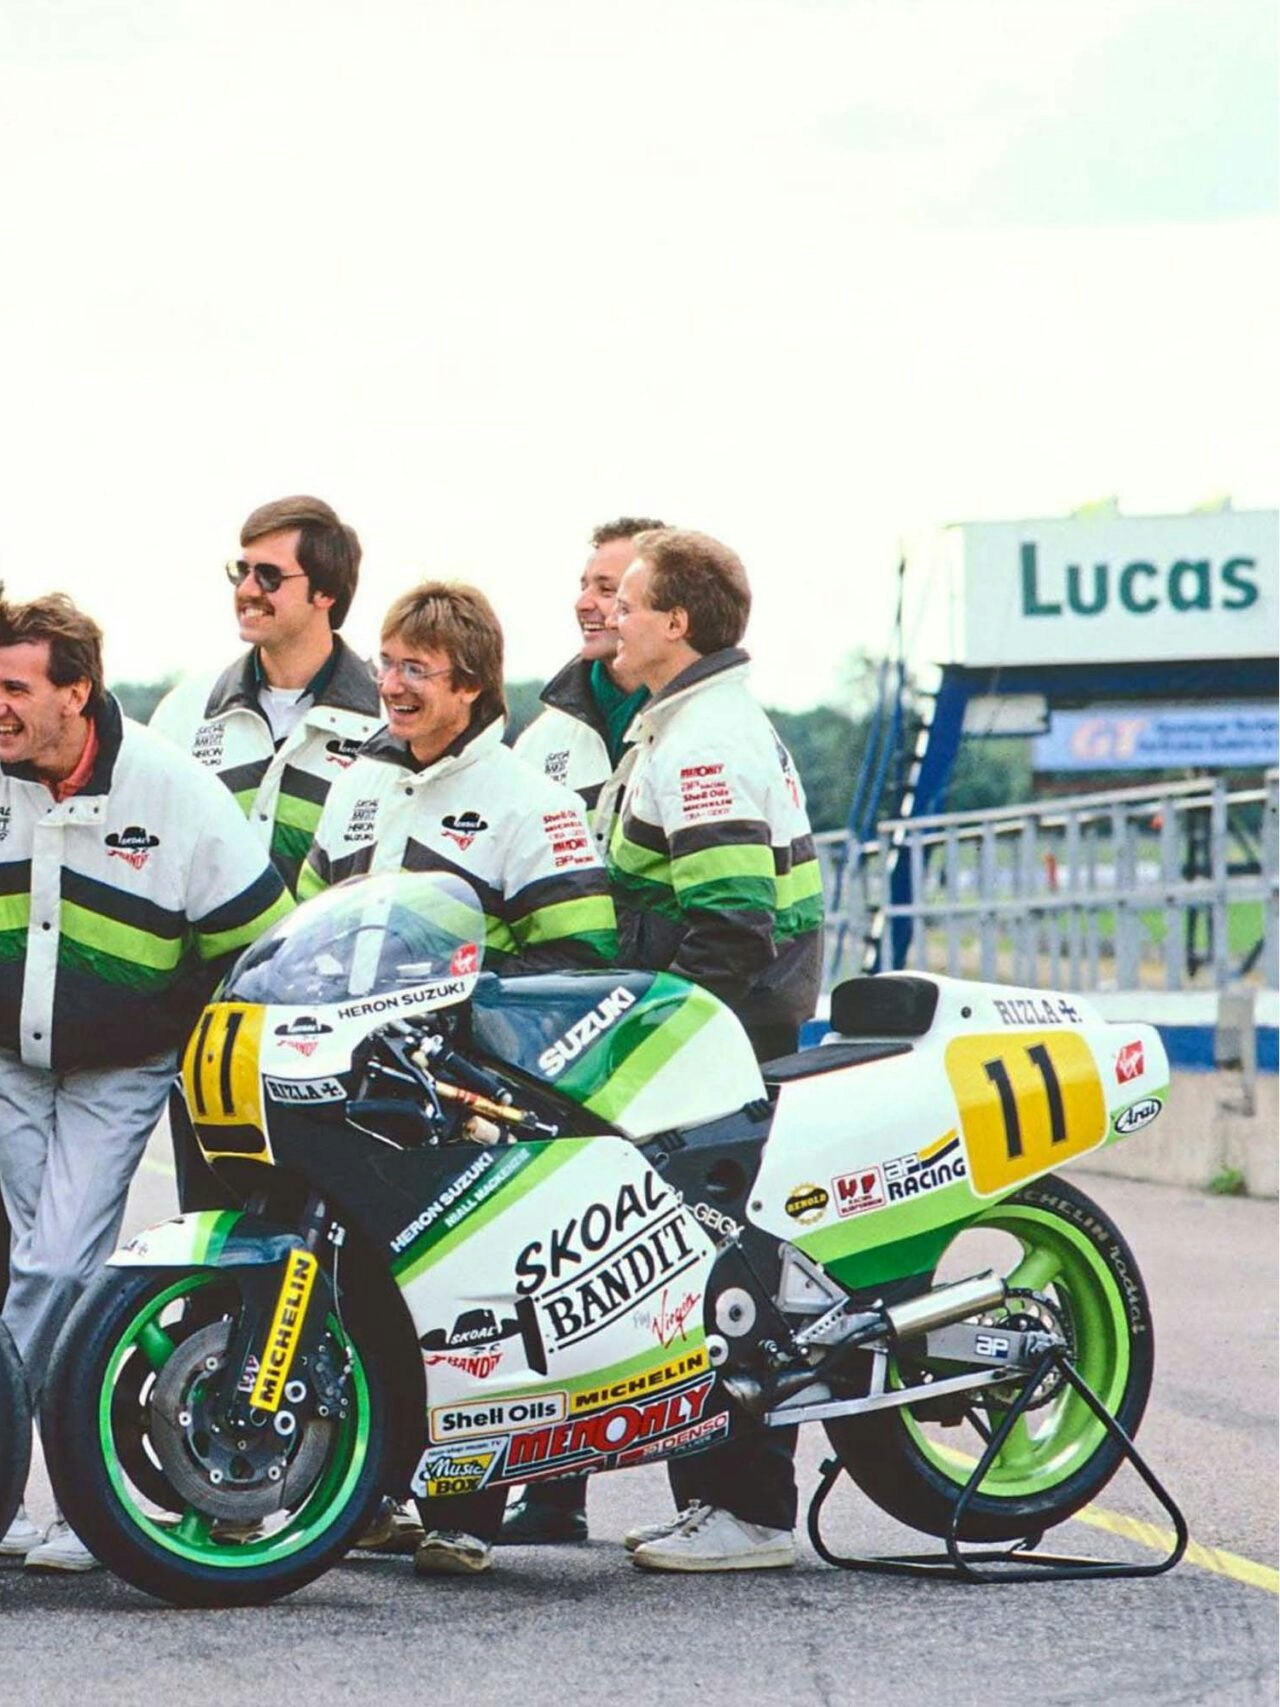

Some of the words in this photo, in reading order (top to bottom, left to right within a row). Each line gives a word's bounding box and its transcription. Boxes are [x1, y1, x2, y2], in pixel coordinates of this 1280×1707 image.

[1020, 542, 1259, 616] Lucas
[338, 997, 399, 1020] HERON
[401, 981, 465, 1006] SUZUKI
[537, 986, 637, 1077] SUZUKI
[192, 1011, 245, 1117] 11
[981, 1042, 1068, 1161] 11
[1122, 1101, 1156, 1130] Arai
[390, 1202, 444, 1253] HERON
[439, 1151, 495, 1206] SUZUKI
[887, 1157, 966, 1201] RACING
[444, 1199, 478, 1228] NIALL
[516, 1171, 668, 1294] SKOAL
[542, 1214, 695, 1342] BANDIT
[259, 1257, 310, 1404] MICHELIN
[451, 1326, 497, 1345] SKOAL
[575, 1353, 703, 1407] MICHELIN
[442, 1408, 504, 1431] Shell
[508, 1402, 556, 1422] Oils
[420, 1456, 486, 1480] Music
